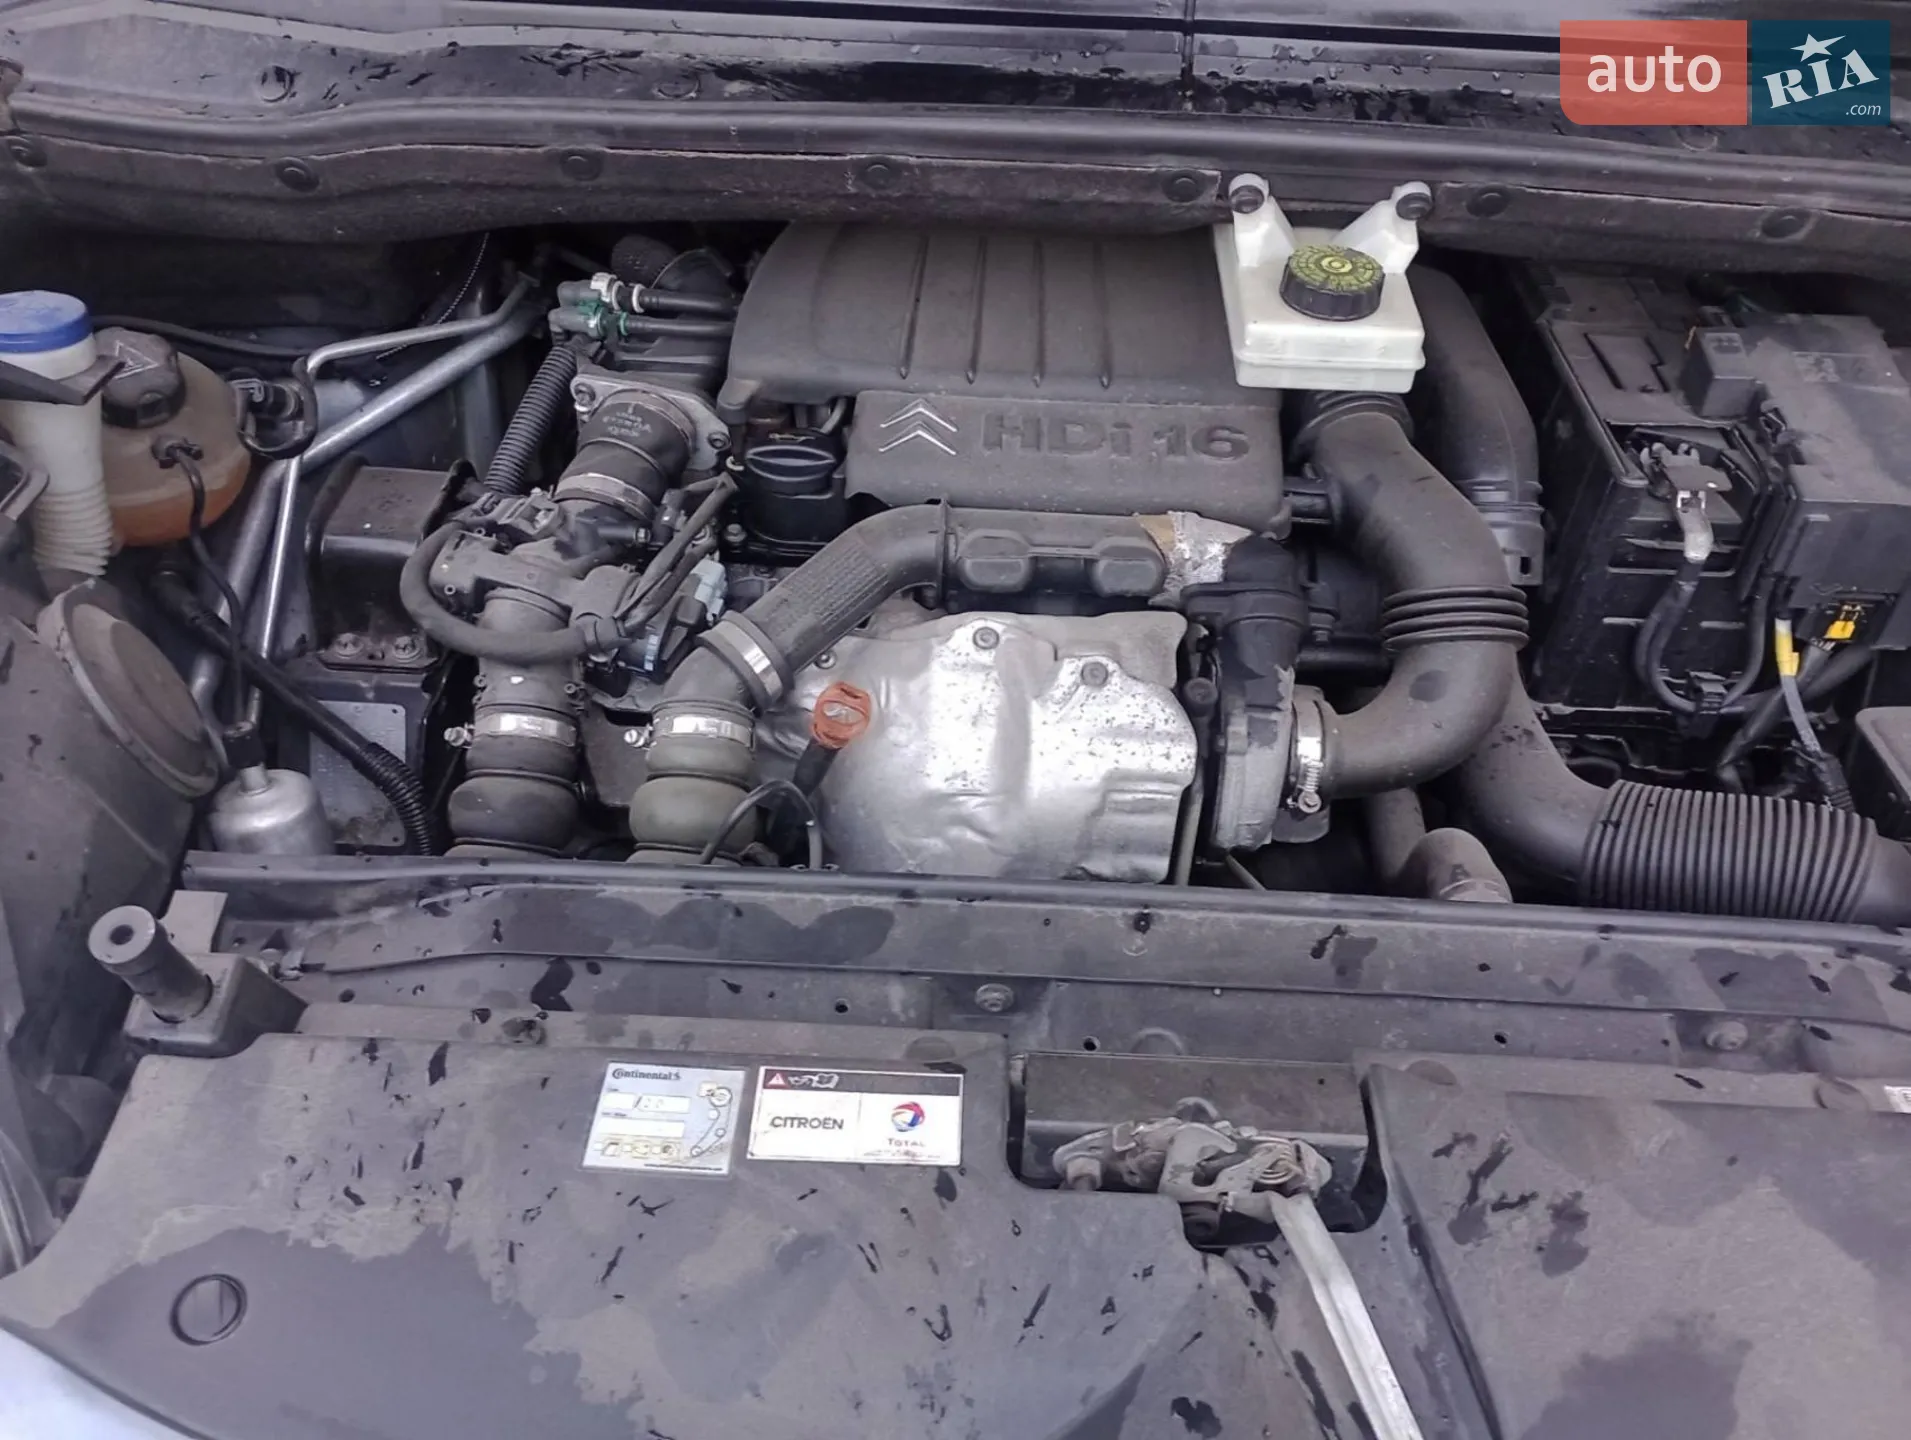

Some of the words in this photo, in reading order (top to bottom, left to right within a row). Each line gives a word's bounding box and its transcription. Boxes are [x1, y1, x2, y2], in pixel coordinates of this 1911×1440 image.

[983, 414, 1134, 457] HDi
[1153, 424, 1250, 460] 16
[612, 1068, 672, 1081] Continental
[770, 1116, 844, 1130] CITROËN
[887, 1138, 926, 1148] TOTAL
